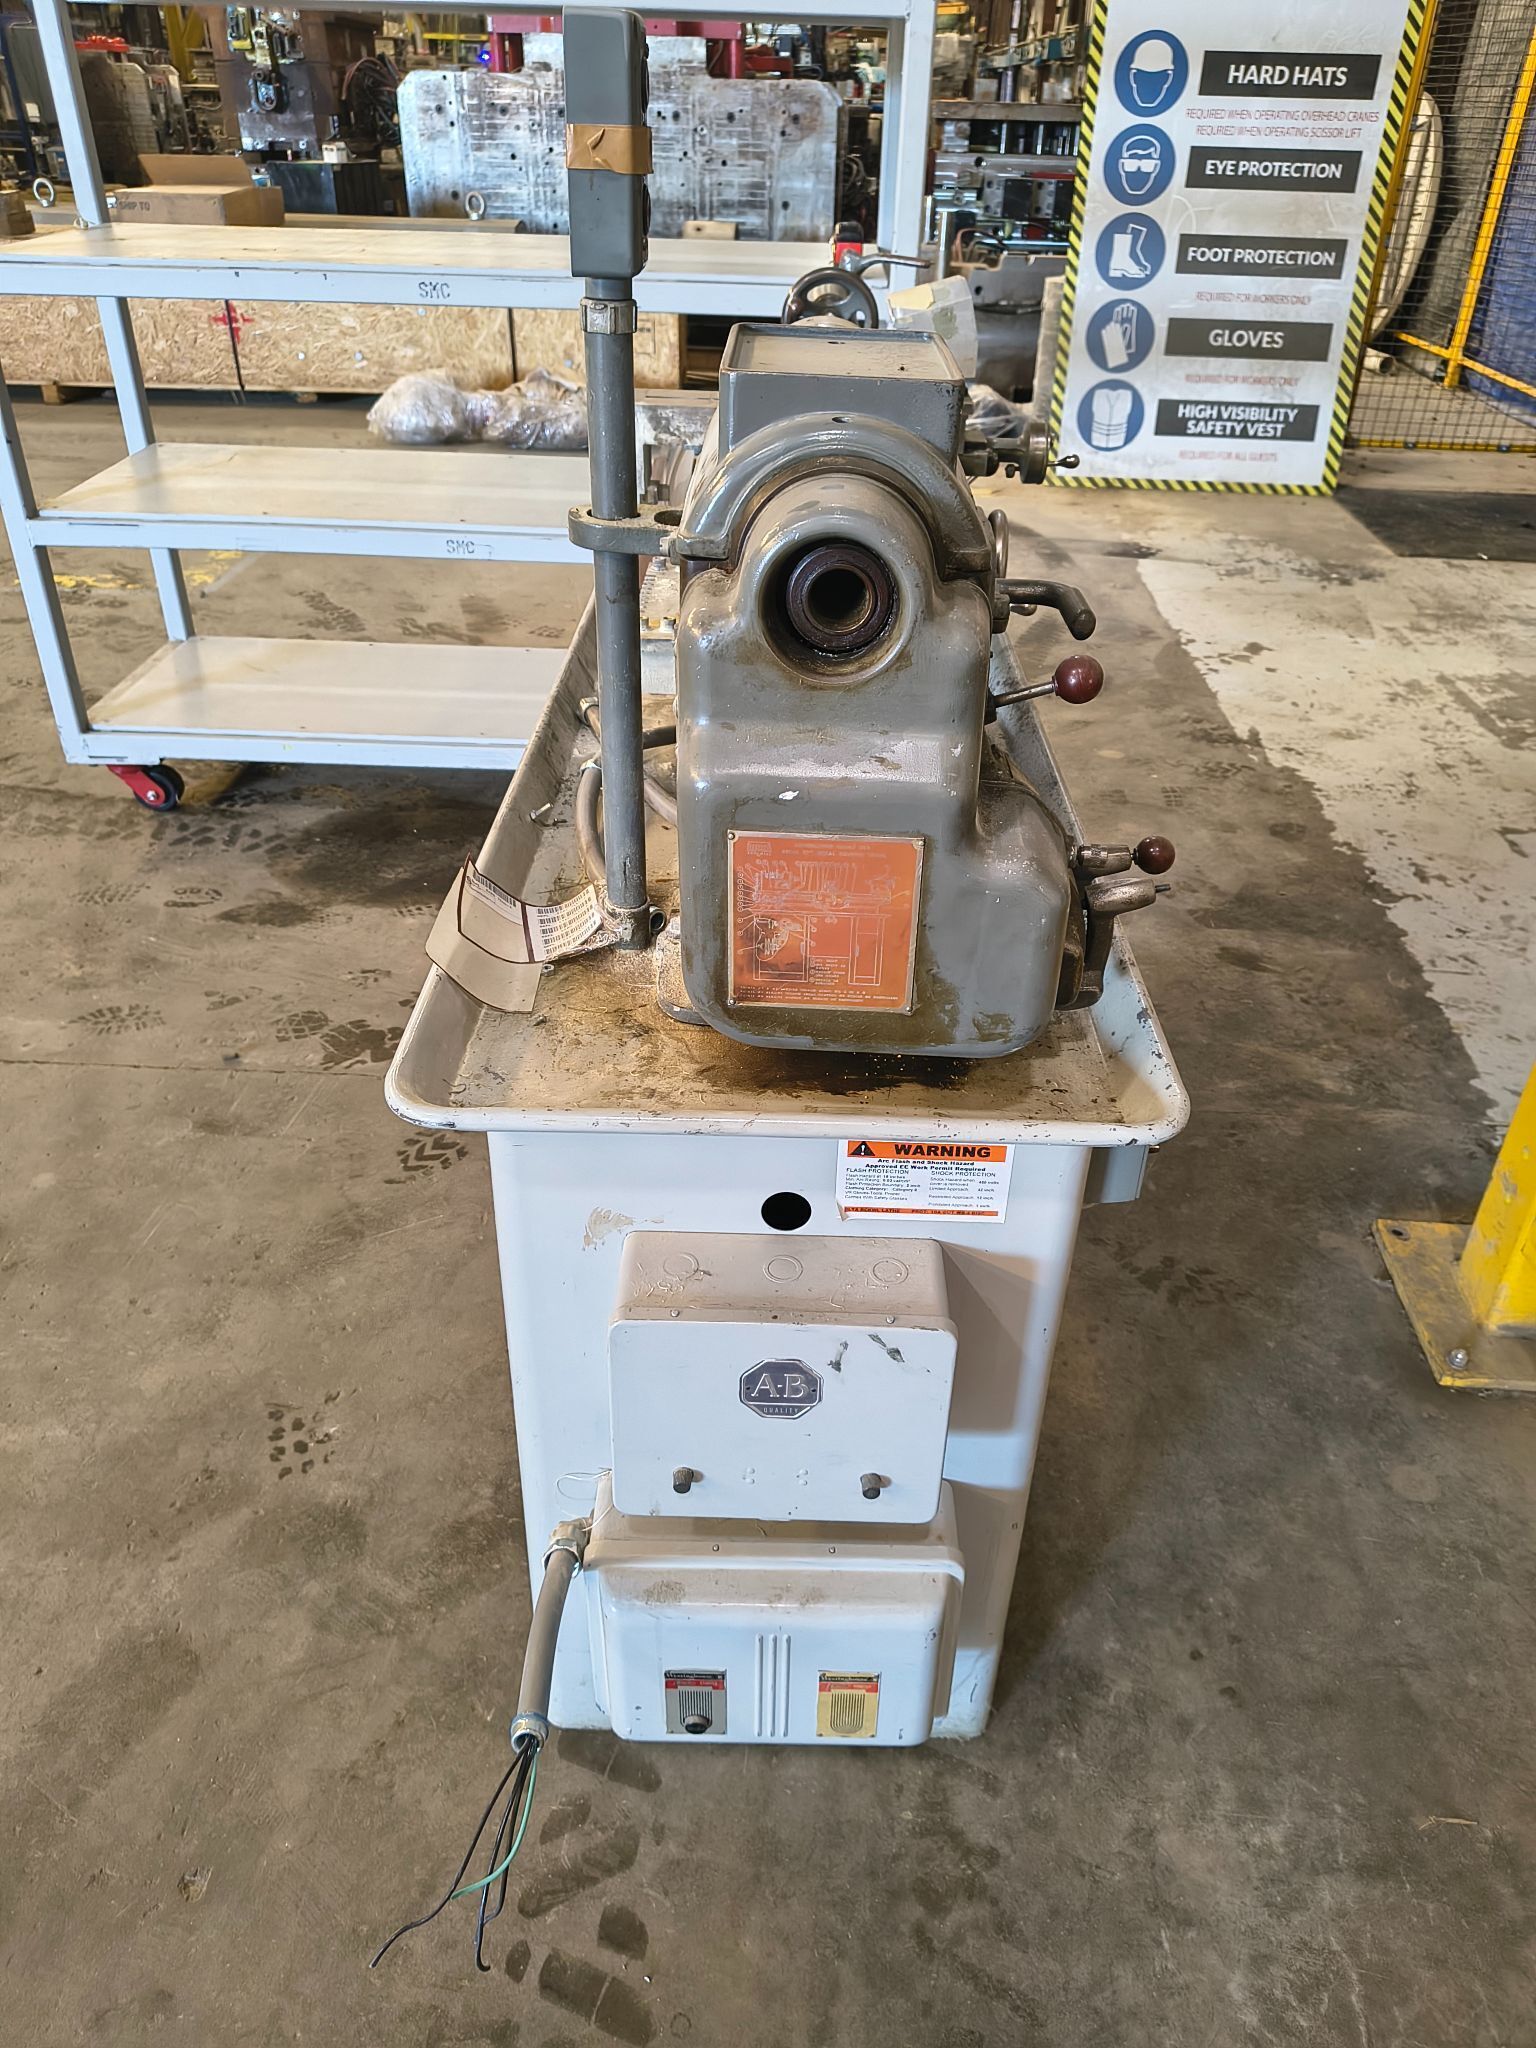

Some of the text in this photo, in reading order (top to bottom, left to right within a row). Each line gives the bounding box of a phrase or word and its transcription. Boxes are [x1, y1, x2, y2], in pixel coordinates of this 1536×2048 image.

[1227, 64, 1348, 87] HARD HATS
[1204, 159, 1343, 179] EYE PROTECTION
[1187, 246, 1336, 266] FOOT PROTECTION
[418, 281, 451, 299] SMC
[1208, 328, 1285, 349] GLOVES
[1177, 403, 1298, 422] HIGH VISIBILITY
[1186, 419, 1285, 438] SAFETY VEST
[446, 539, 475, 555] SMC
[894, 1143, 991, 1158] WARNING
[750, 1373, 810, 1398] A-B
